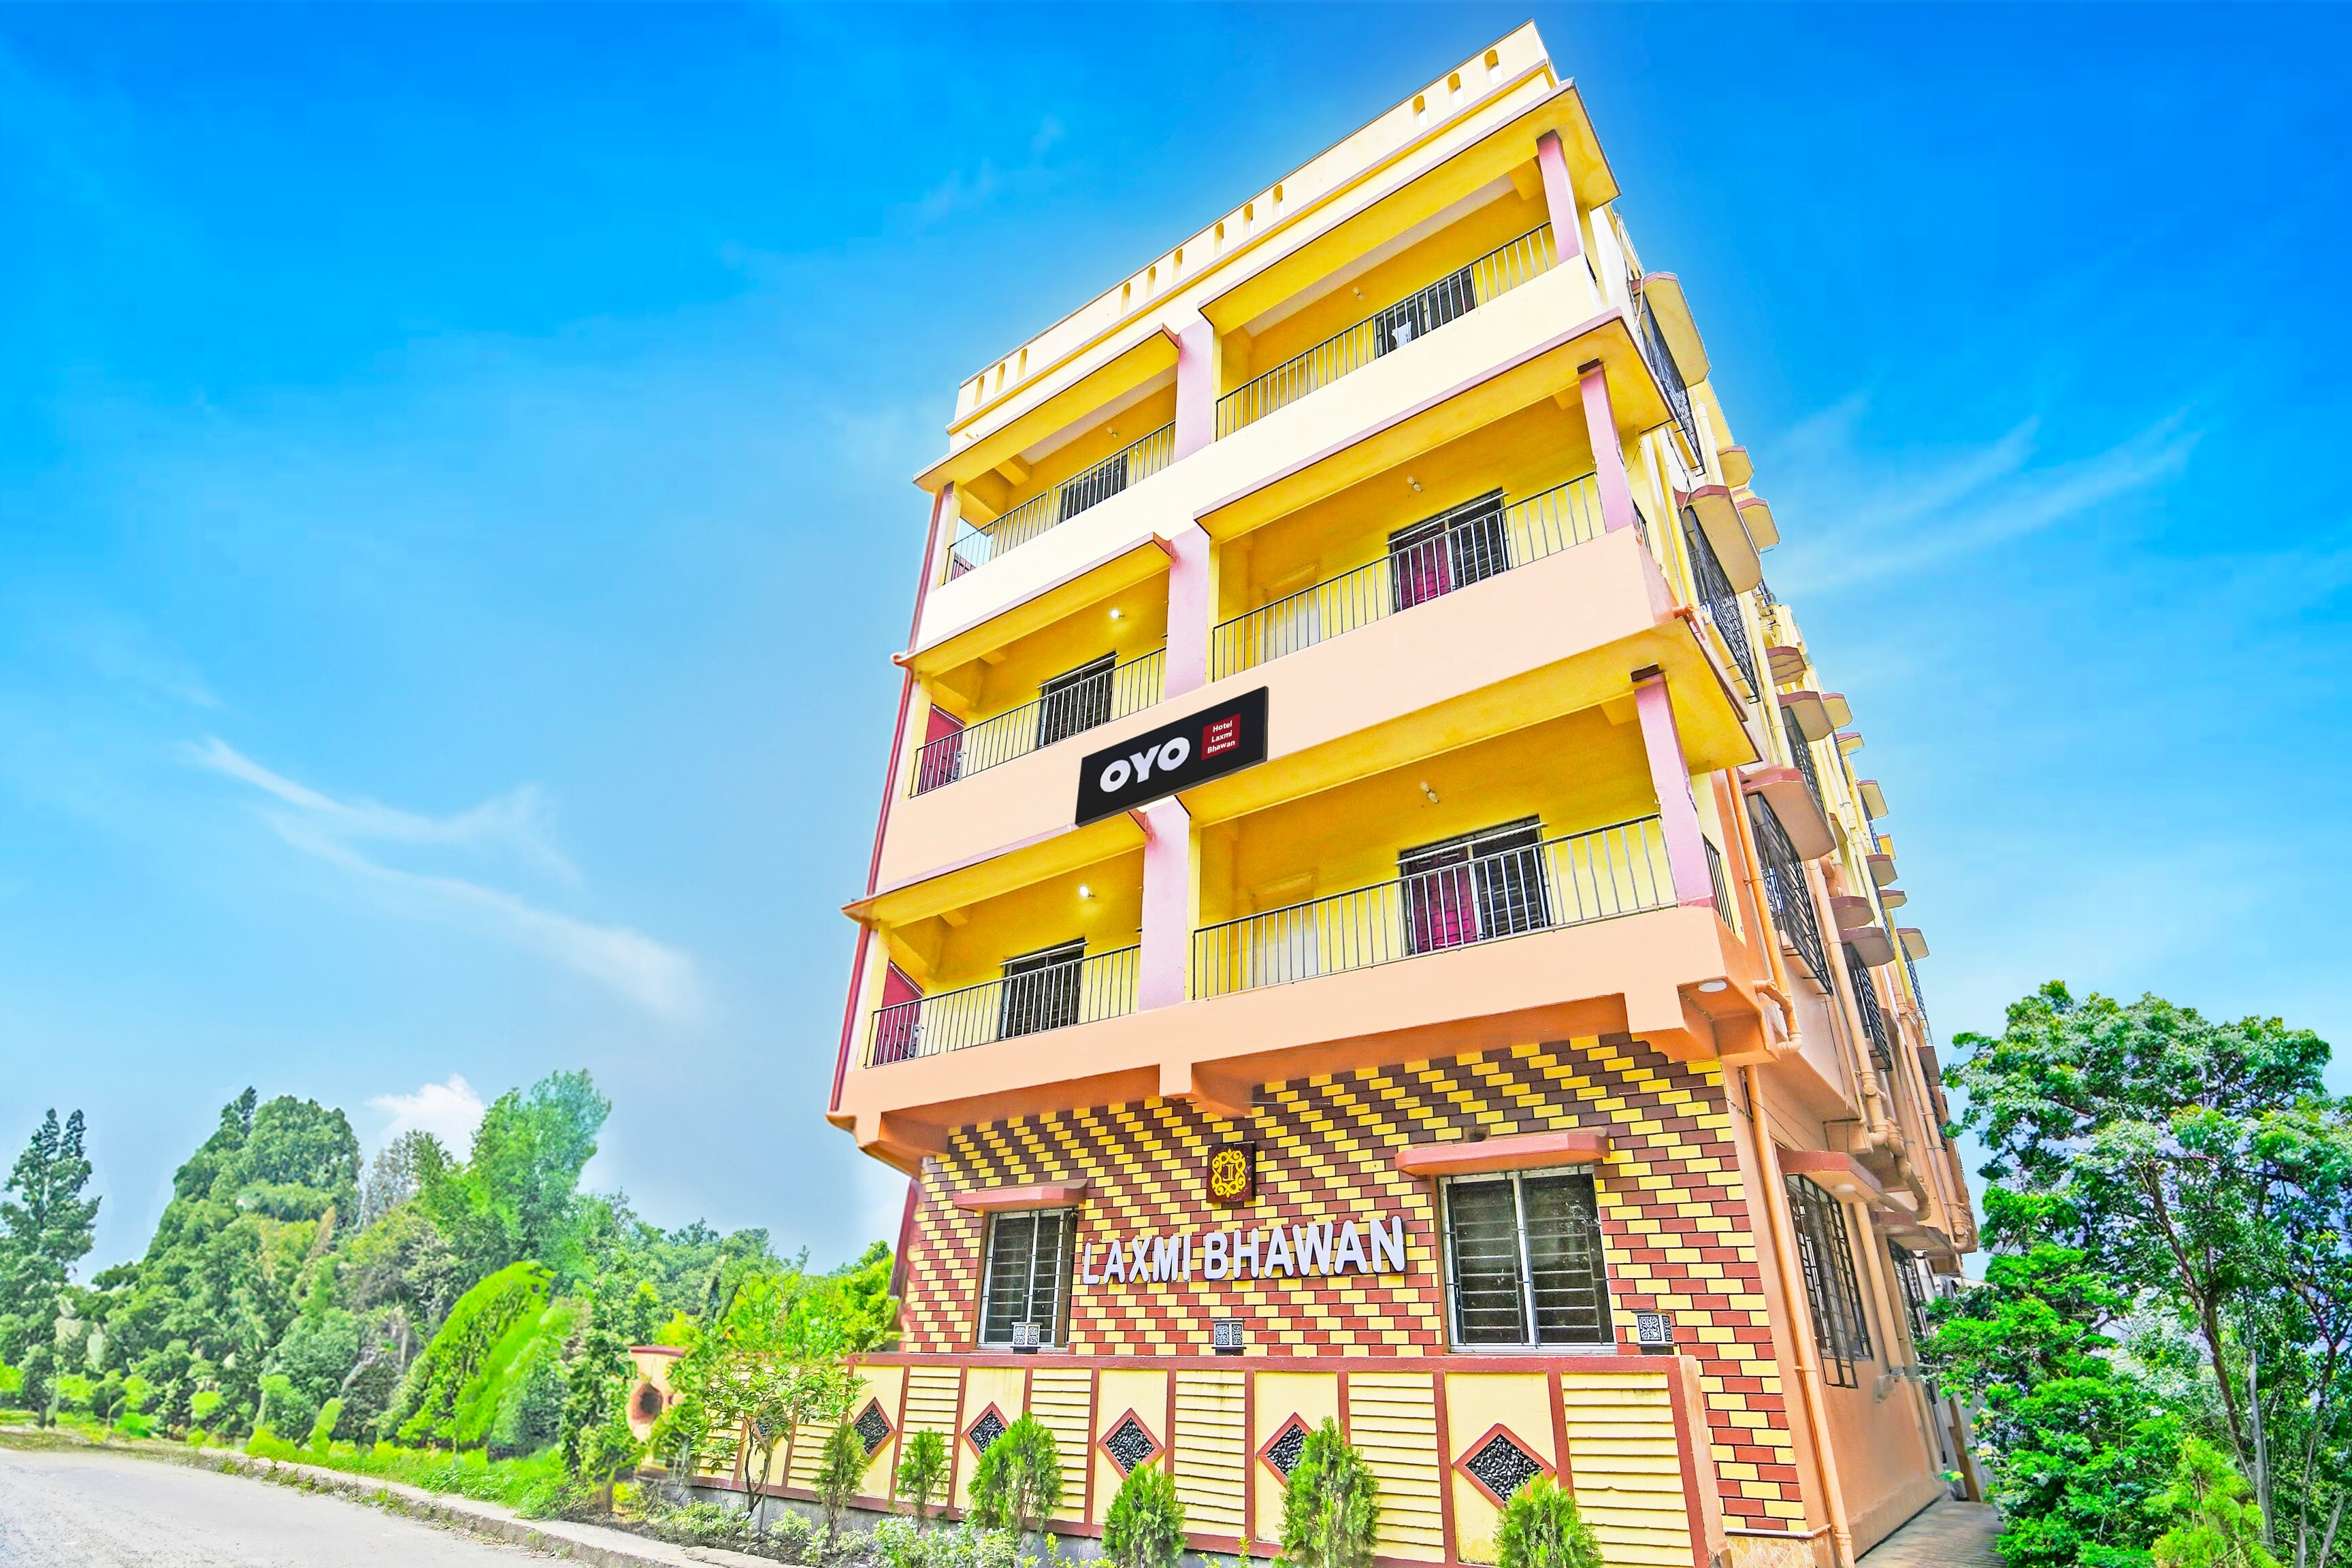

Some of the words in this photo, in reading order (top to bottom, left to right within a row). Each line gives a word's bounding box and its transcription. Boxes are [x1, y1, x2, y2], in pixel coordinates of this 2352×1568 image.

[1213, 721, 1232, 732] Hotel
[1211, 730, 1232, 743] Laxmi
[1207, 740, 1235, 753] Bhawan
[1100, 736, 1190, 793] OYO
[1083, 1235, 1191, 1285] LAXMI
[1204, 1215, 1406, 1280] BHAWAN
